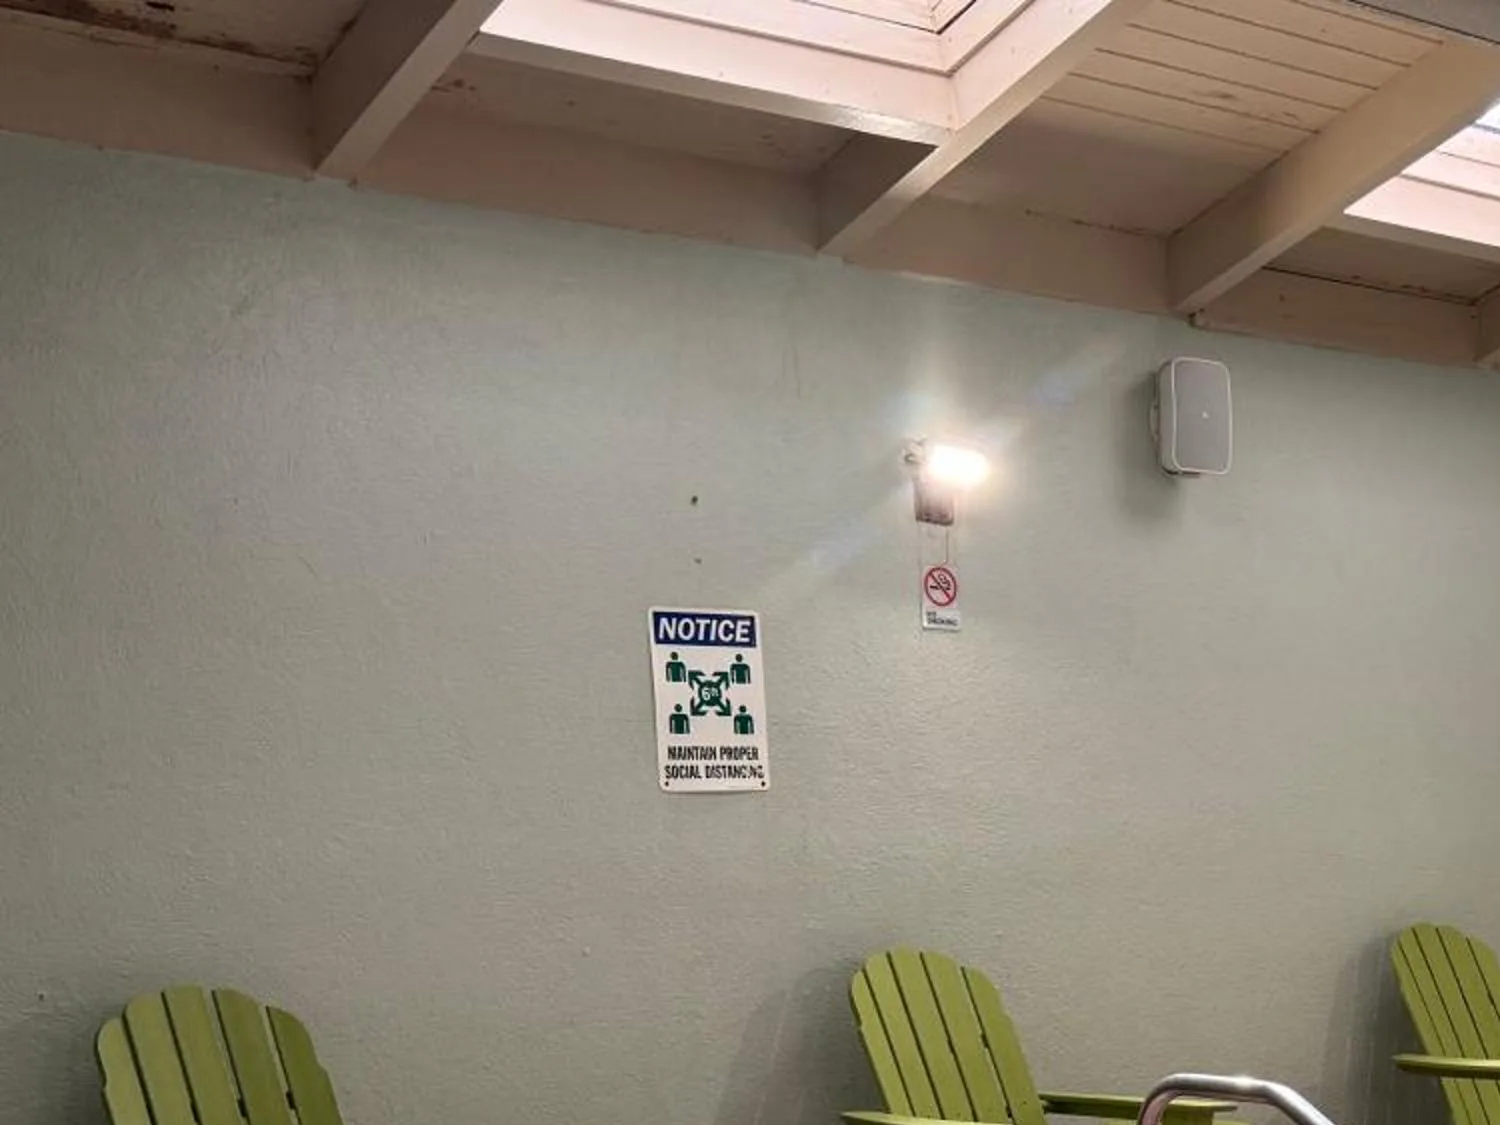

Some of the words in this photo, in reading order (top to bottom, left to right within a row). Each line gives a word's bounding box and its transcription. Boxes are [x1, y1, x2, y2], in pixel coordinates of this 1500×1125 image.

[658, 617, 751, 643] NOTICE
[667, 745, 717, 760] MAINTAIN
[719, 746, 759, 760] PROPER
[664, 765, 702, 779] SOCIAL
